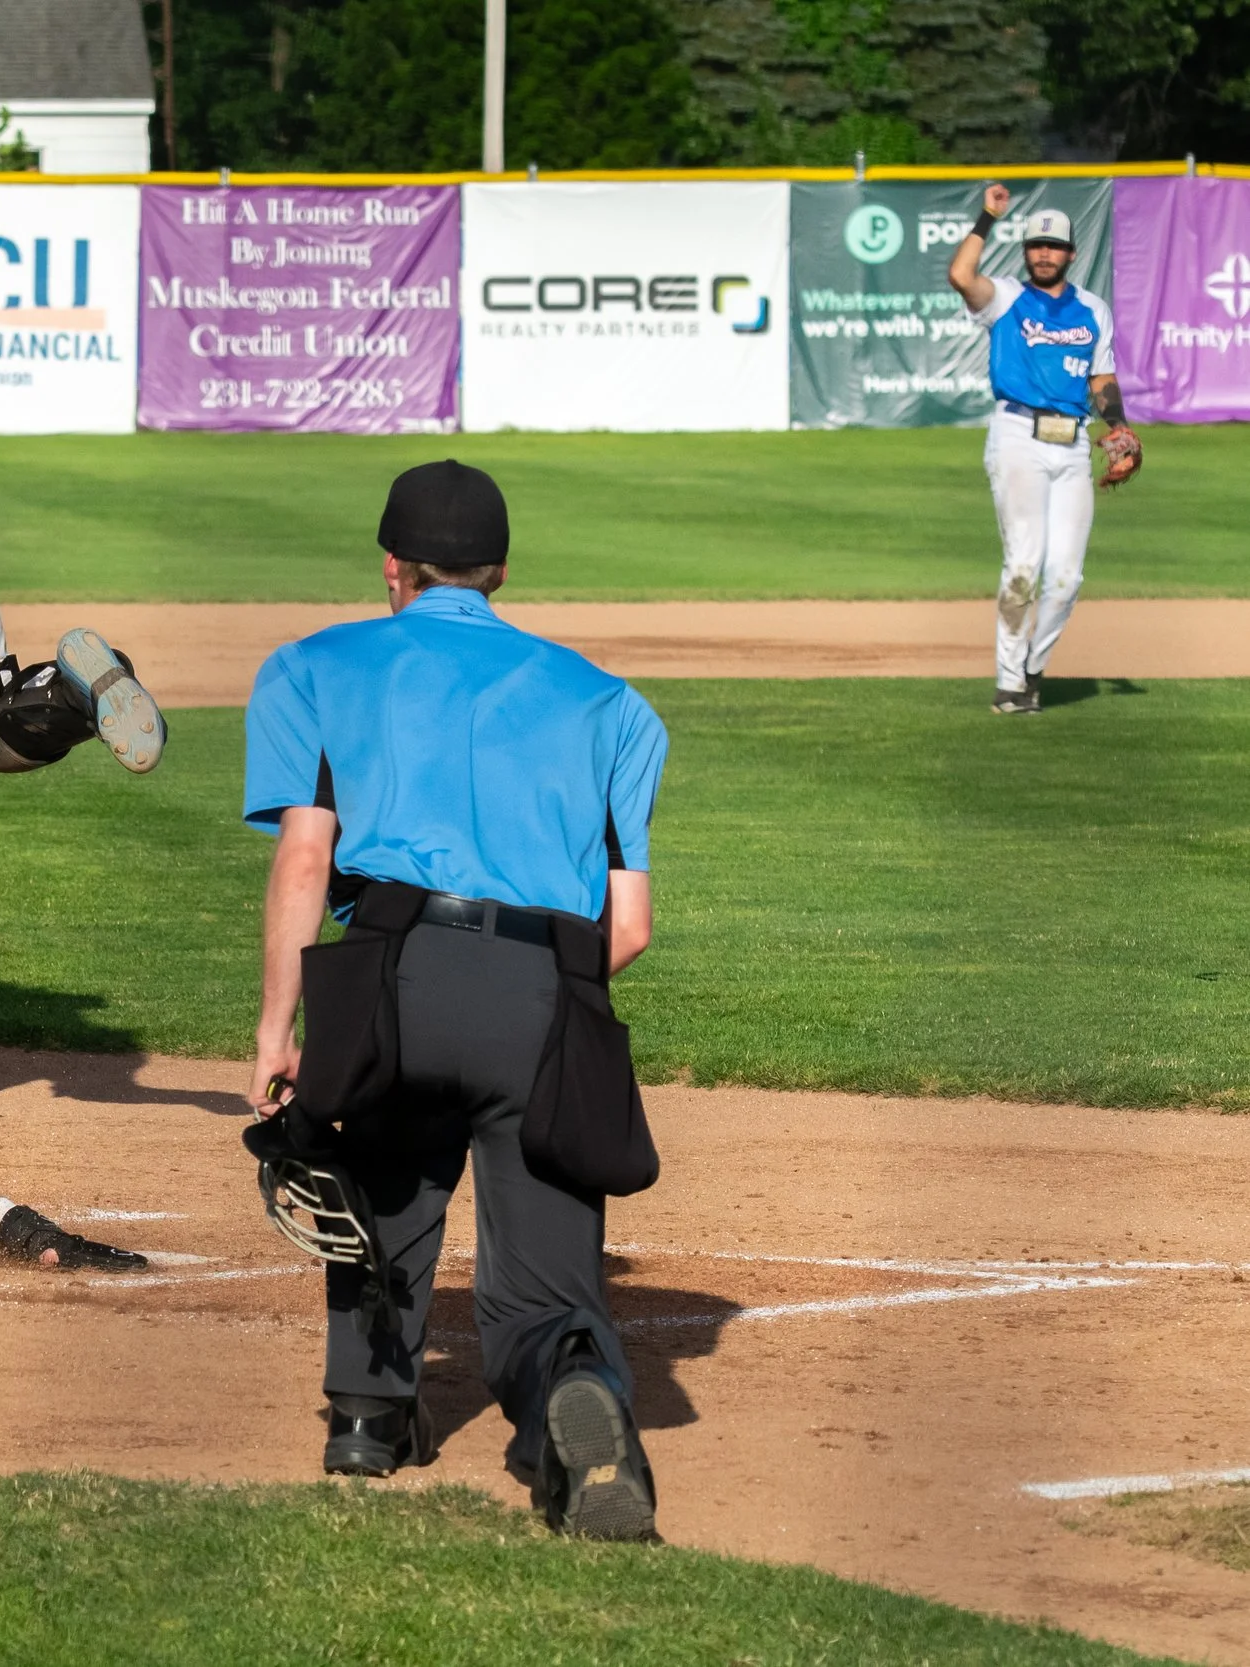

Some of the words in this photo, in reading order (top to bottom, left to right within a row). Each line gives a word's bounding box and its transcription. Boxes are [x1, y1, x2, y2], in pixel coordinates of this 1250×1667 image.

[181, 197, 227, 225] Hit
[233, 198, 259, 225] A
[266, 197, 355, 226] Home
[363, 198, 420, 226] Run
[230, 237, 269, 269] By
[269, 237, 372, 269] Joining
[148, 276, 319, 315] Muskegon
[328, 276, 451, 310] Federal
[482, 275, 699, 312] CORE
[802, 289, 915, 312] Whatever
[188, 324, 292, 357] Credit
[302, 325, 410, 358] Union
[480, 321, 566, 339] REALTY
[577, 321, 701, 339] PARTNERS
[802, 315, 870, 338] we're
[872, 313, 926, 338] with
[1158, 322, 1234, 353] Trinity
[199, 378, 405, 409] 231-722-7285
